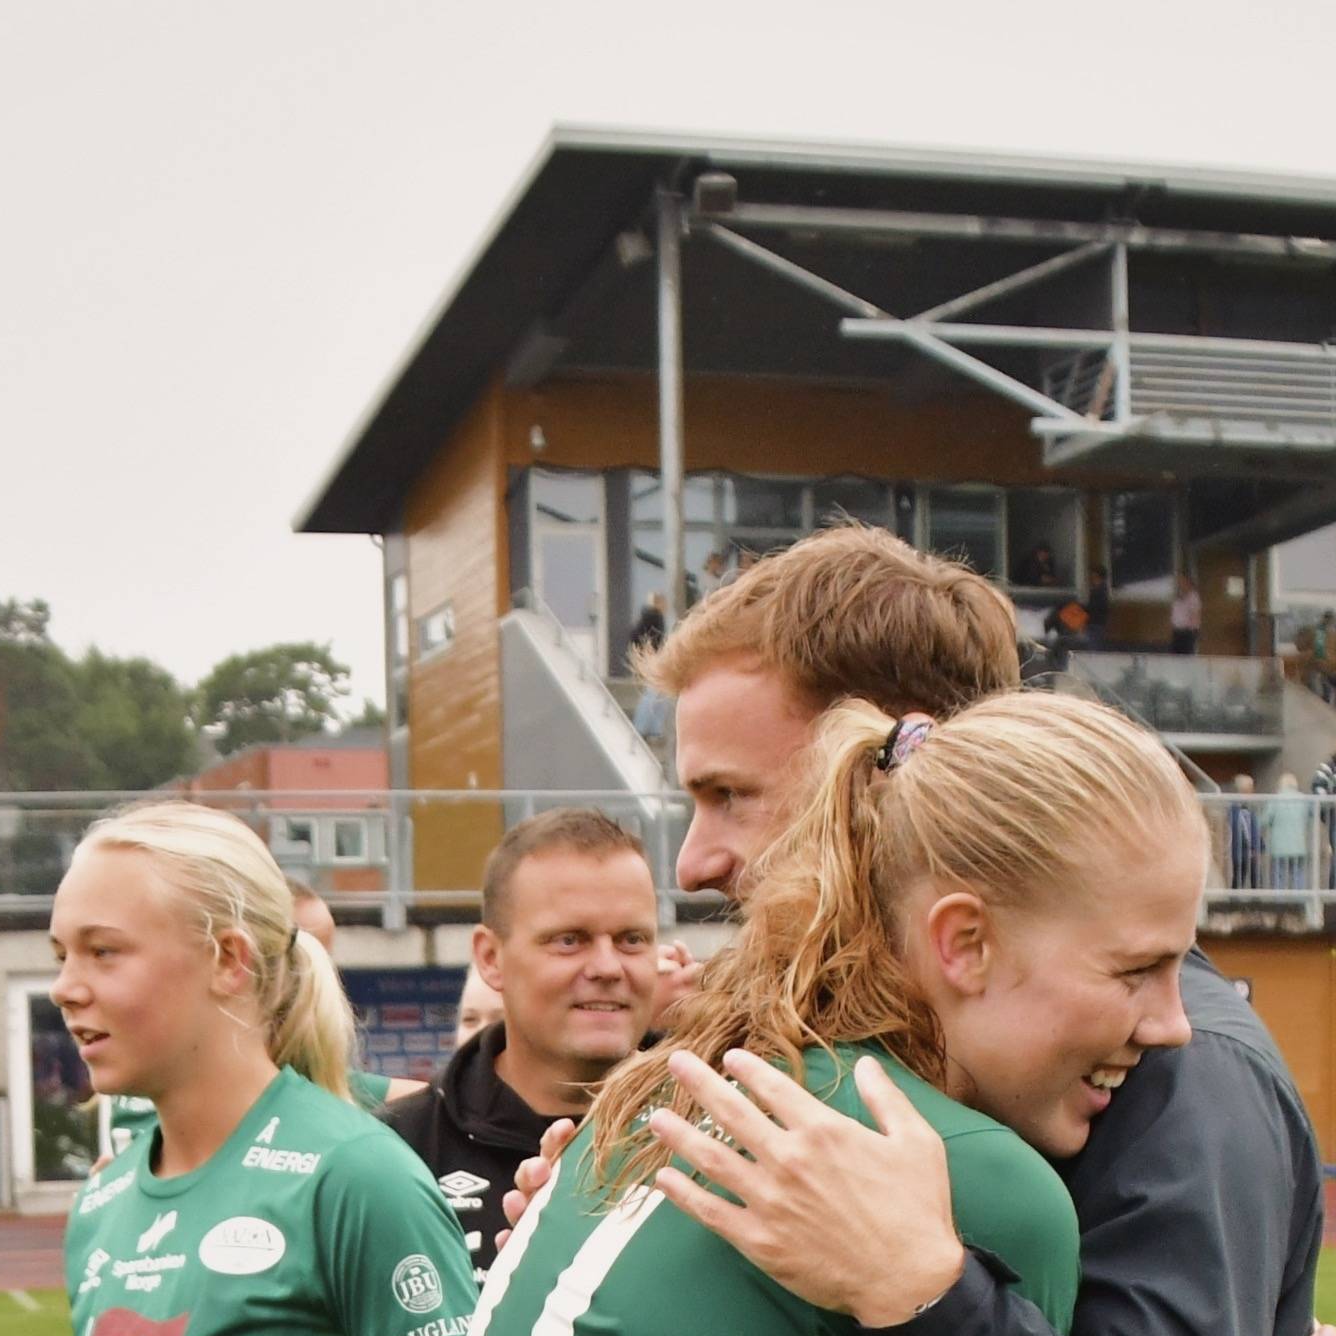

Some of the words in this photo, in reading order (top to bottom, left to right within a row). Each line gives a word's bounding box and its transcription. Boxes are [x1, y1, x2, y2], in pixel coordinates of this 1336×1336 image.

[242, 1145, 321, 1174] ENERGI
[445, 1194, 483, 1209] mbro
[399, 1271, 439, 1302] JBU
